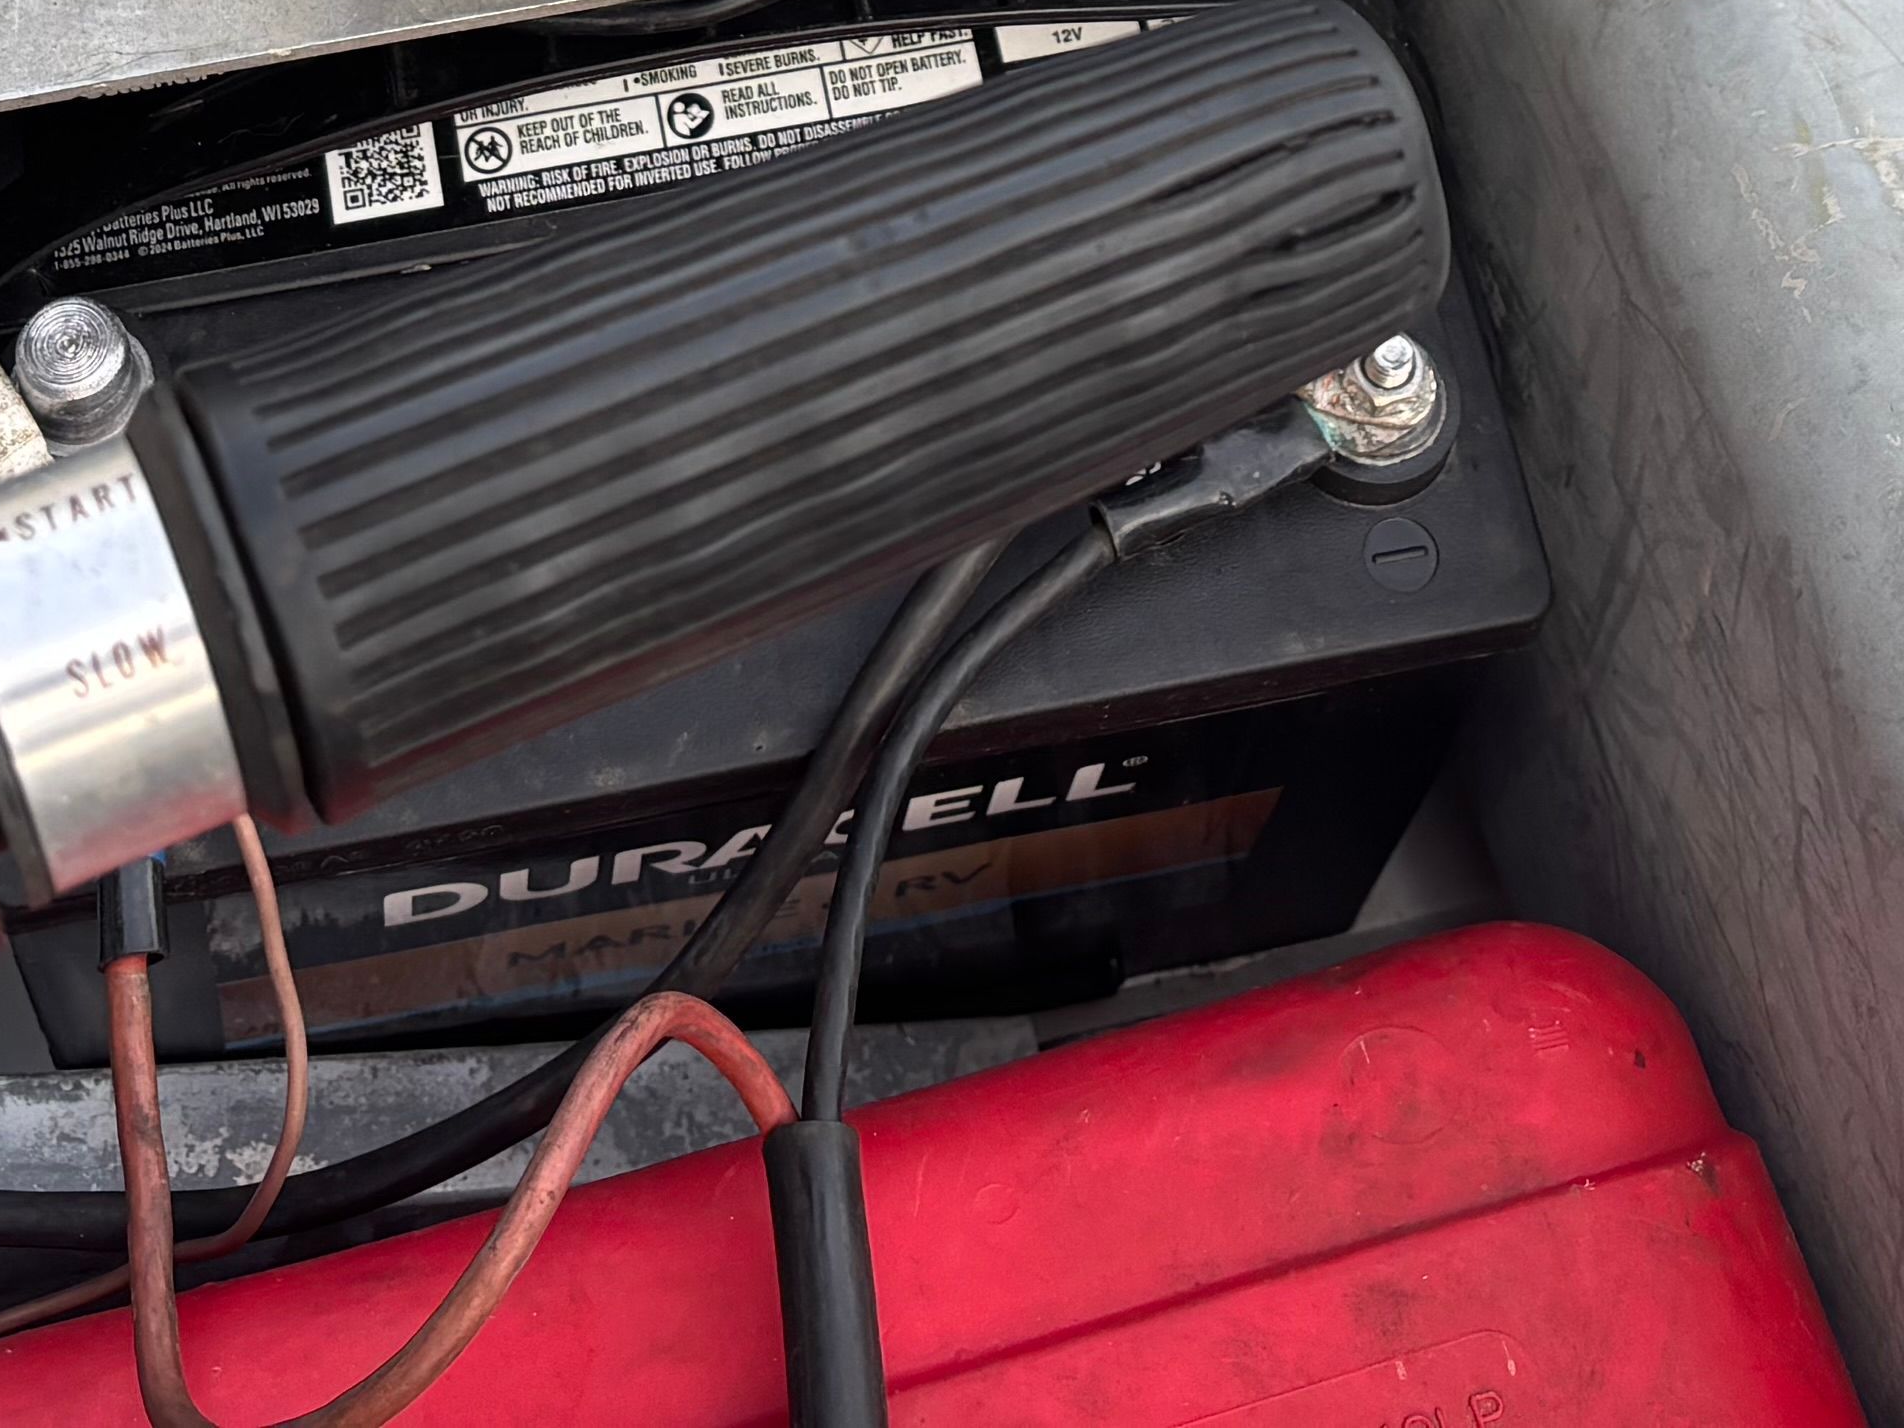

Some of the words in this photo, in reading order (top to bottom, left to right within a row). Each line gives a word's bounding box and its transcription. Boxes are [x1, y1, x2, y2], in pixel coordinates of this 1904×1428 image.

[1051, 26, 1083, 45] 12V
[725, 55, 772, 77] SEVERE
[773, 48, 821, 69] BURNS.
[828, 69, 846, 85] DO
[849, 64, 874, 82] NOT
[876, 59, 909, 77] OPEN
[911, 49, 967, 72] BATTERY.
[721, 85, 754, 104] READ
[757, 80, 780, 98] ALL
[832, 84, 849, 101] DO
[853, 80, 877, 97] NOT
[878, 77, 903, 93] TIP.
[724, 90, 818, 121] INSTRUCTIONS.
[516, 120, 548, 139] KEEP
[551, 115, 576, 132] OUT
[579, 112, 595, 128] OF
[597, 107, 622, 124] THE
[519, 134, 561, 155] REACH
[564, 131, 580, 147] OF
[583, 119, 649, 145] CHILDREN.
[478, 174, 540, 198] WARNING:
[541, 168, 572, 187] RISK
[572, 164, 588, 181] OF
[623, 147, 690, 173] EXPLOSION
[692, 144, 710, 161] OR
[711, 137, 757, 157] BURNS.
[757, 133, 776, 150] DO
[778, 128, 802, 146] NOT
[237, 176, 265, 191] rights
[486, 195, 511, 213] NOT
[514, 181, 606, 209] RECOMMENDED
[607, 174, 633, 192] FOR
[634, 163, 692, 187] INVERTED
[723, 150, 772, 171] FOLLOW
[161, 204, 189, 221] Plus
[190, 197, 215, 218] LLC
[82, 232, 128, 253] Walnut
[128, 226, 164, 246] Ridge
[262, 204, 282, 222] WI
[282, 197, 320, 219] 53029
[173, 234, 219, 251] Batteries
[245, 226, 264, 239] LLC
[13, 472, 138, 542] START
[65, 624, 170, 699] SLOW
